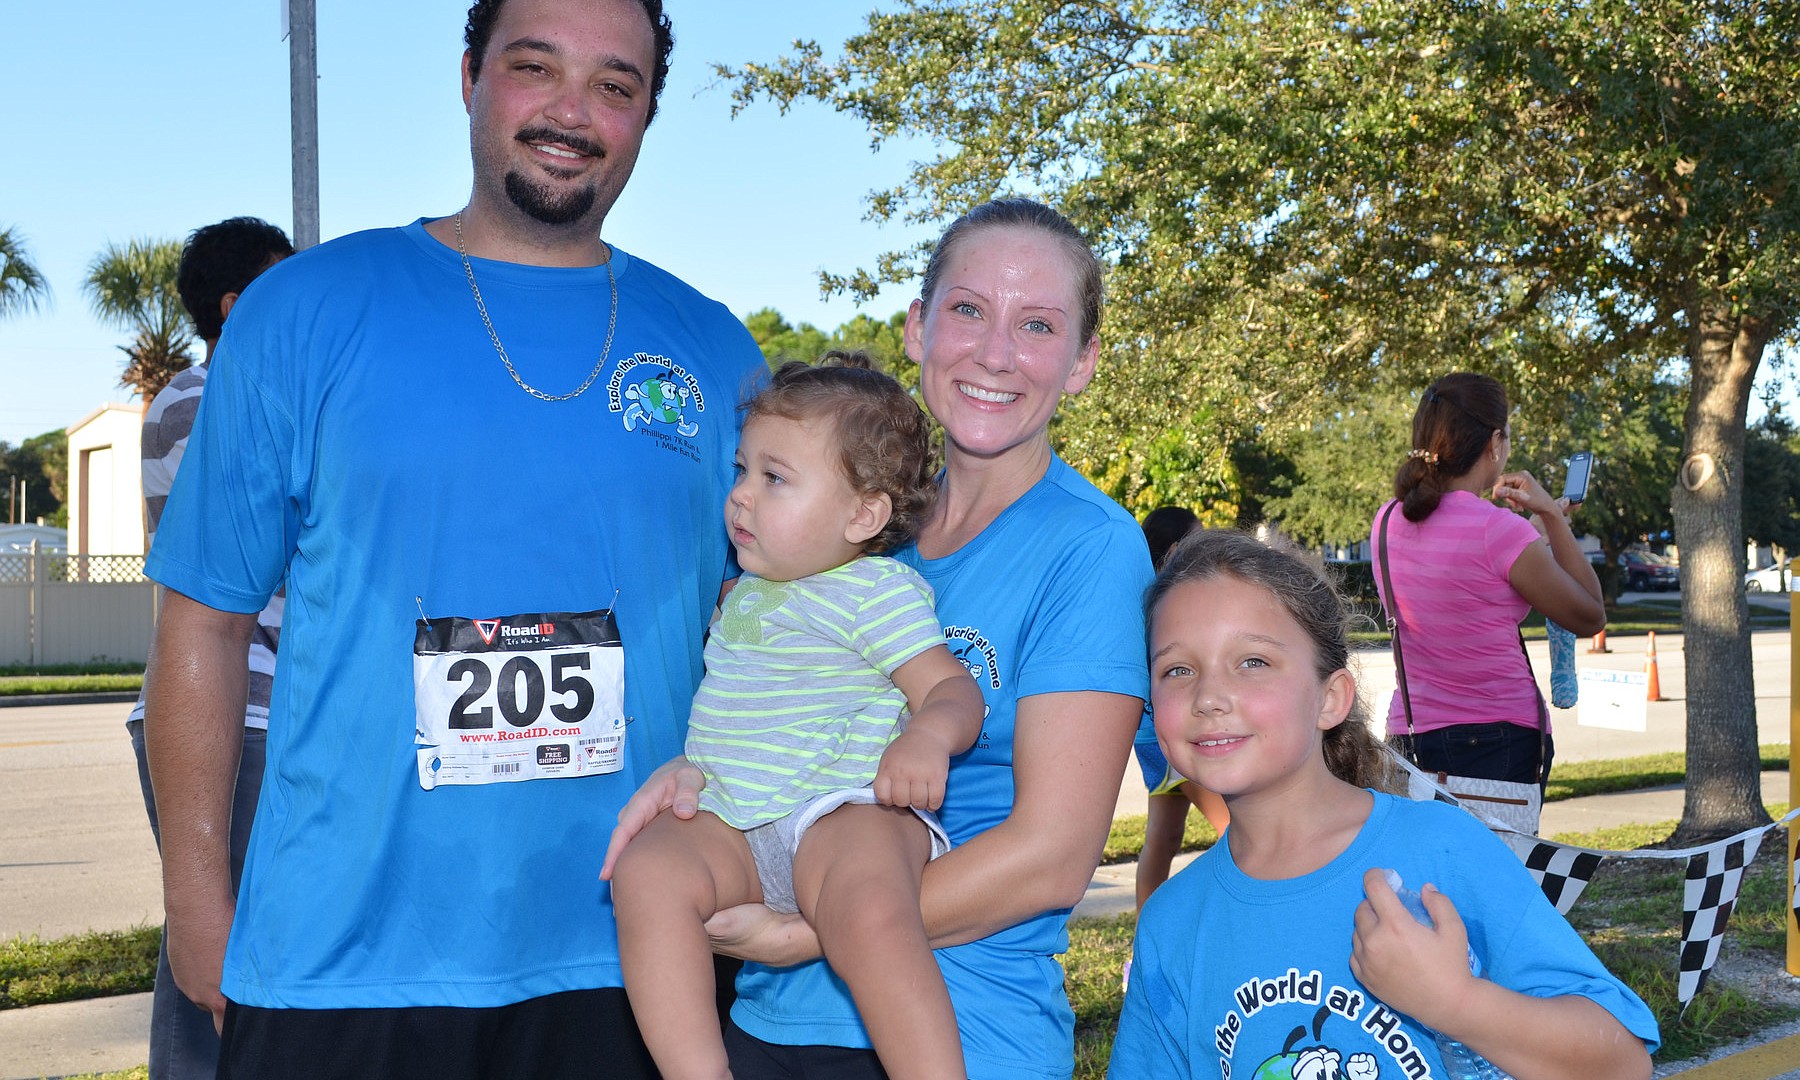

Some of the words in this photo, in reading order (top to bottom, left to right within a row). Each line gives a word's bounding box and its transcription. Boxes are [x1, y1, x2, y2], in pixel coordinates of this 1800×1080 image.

[607, 370, 624, 412] Explore
[619, 358, 637, 371] the
[635, 353, 671, 368] World
[673, 365, 685, 377] at
[684, 375, 704, 411] Home
[641, 428, 671, 441] Phillippi
[684, 440, 696, 451] Run
[662, 441, 678, 452] Mile
[680, 447, 691, 457] Fun
[691, 452, 701, 463] Run
[501, 623, 555, 637] RoadID
[945, 626, 978, 642] World
[975, 637, 988, 650] at
[984, 648, 1001, 689] Home
[447, 652, 594, 729] 205
[460, 727, 581, 742] www.RoadID.com
[982, 731, 991, 740] &
[1215, 1012, 1240, 1056] the
[1236, 972, 1319, 1014] World
[1329, 989, 1361, 1017] at
[1365, 1006, 1430, 1080] Hom
